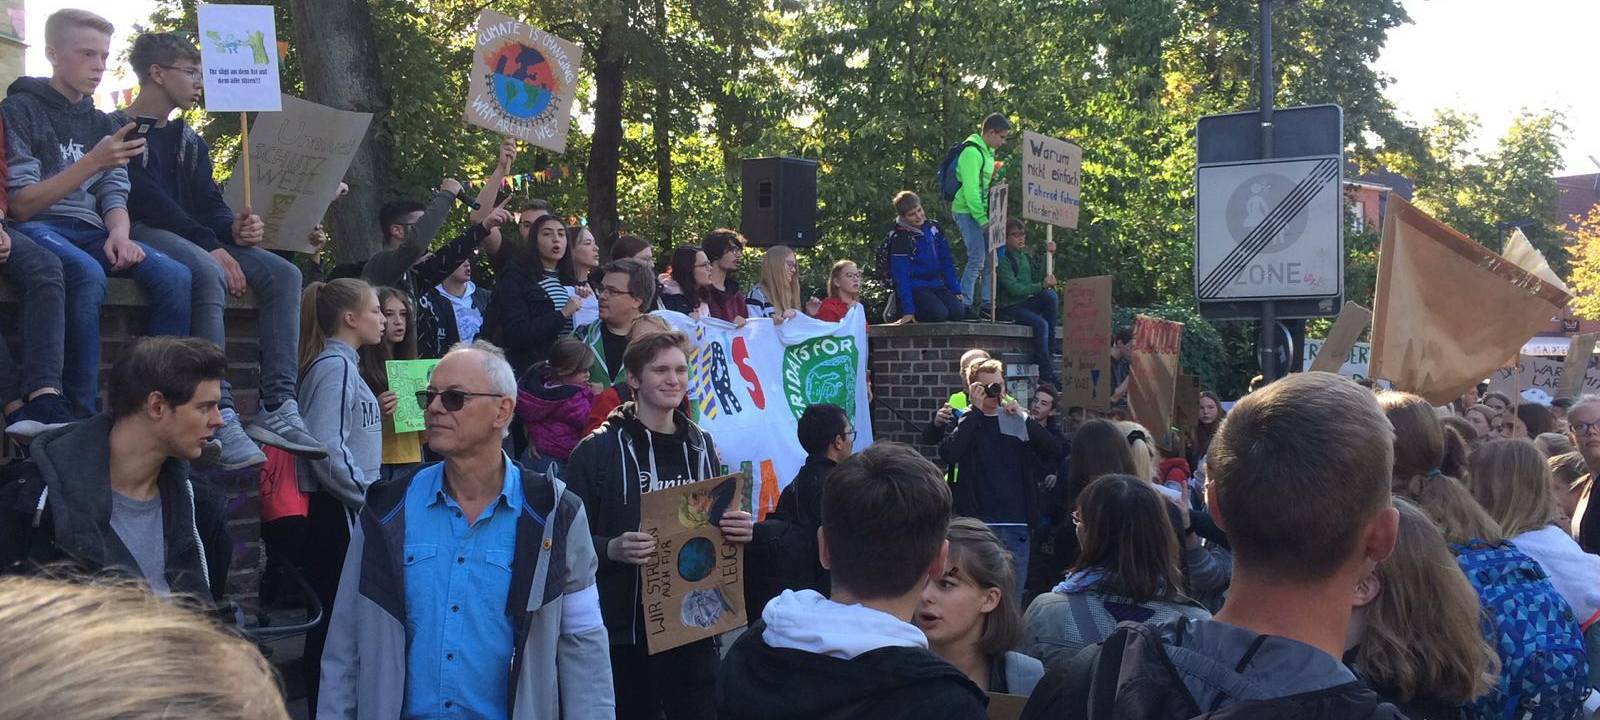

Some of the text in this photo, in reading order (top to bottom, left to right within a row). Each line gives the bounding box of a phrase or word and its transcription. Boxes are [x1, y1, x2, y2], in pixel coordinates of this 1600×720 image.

[479, 21, 575, 84] CLIMATE IS CHANGING
[472, 95, 497, 121] WHY
[534, 118, 559, 140] WE?
[1029, 139, 1070, 166] Warum
[1027, 163, 1079, 187] nicht einfach
[1027, 182, 1058, 201] Fahrrad
[1234, 262, 1302, 285] ZONE
[813, 338, 852, 356] FOR
[720, 538, 738, 586] LEUG
[648, 601, 666, 636] WIR
